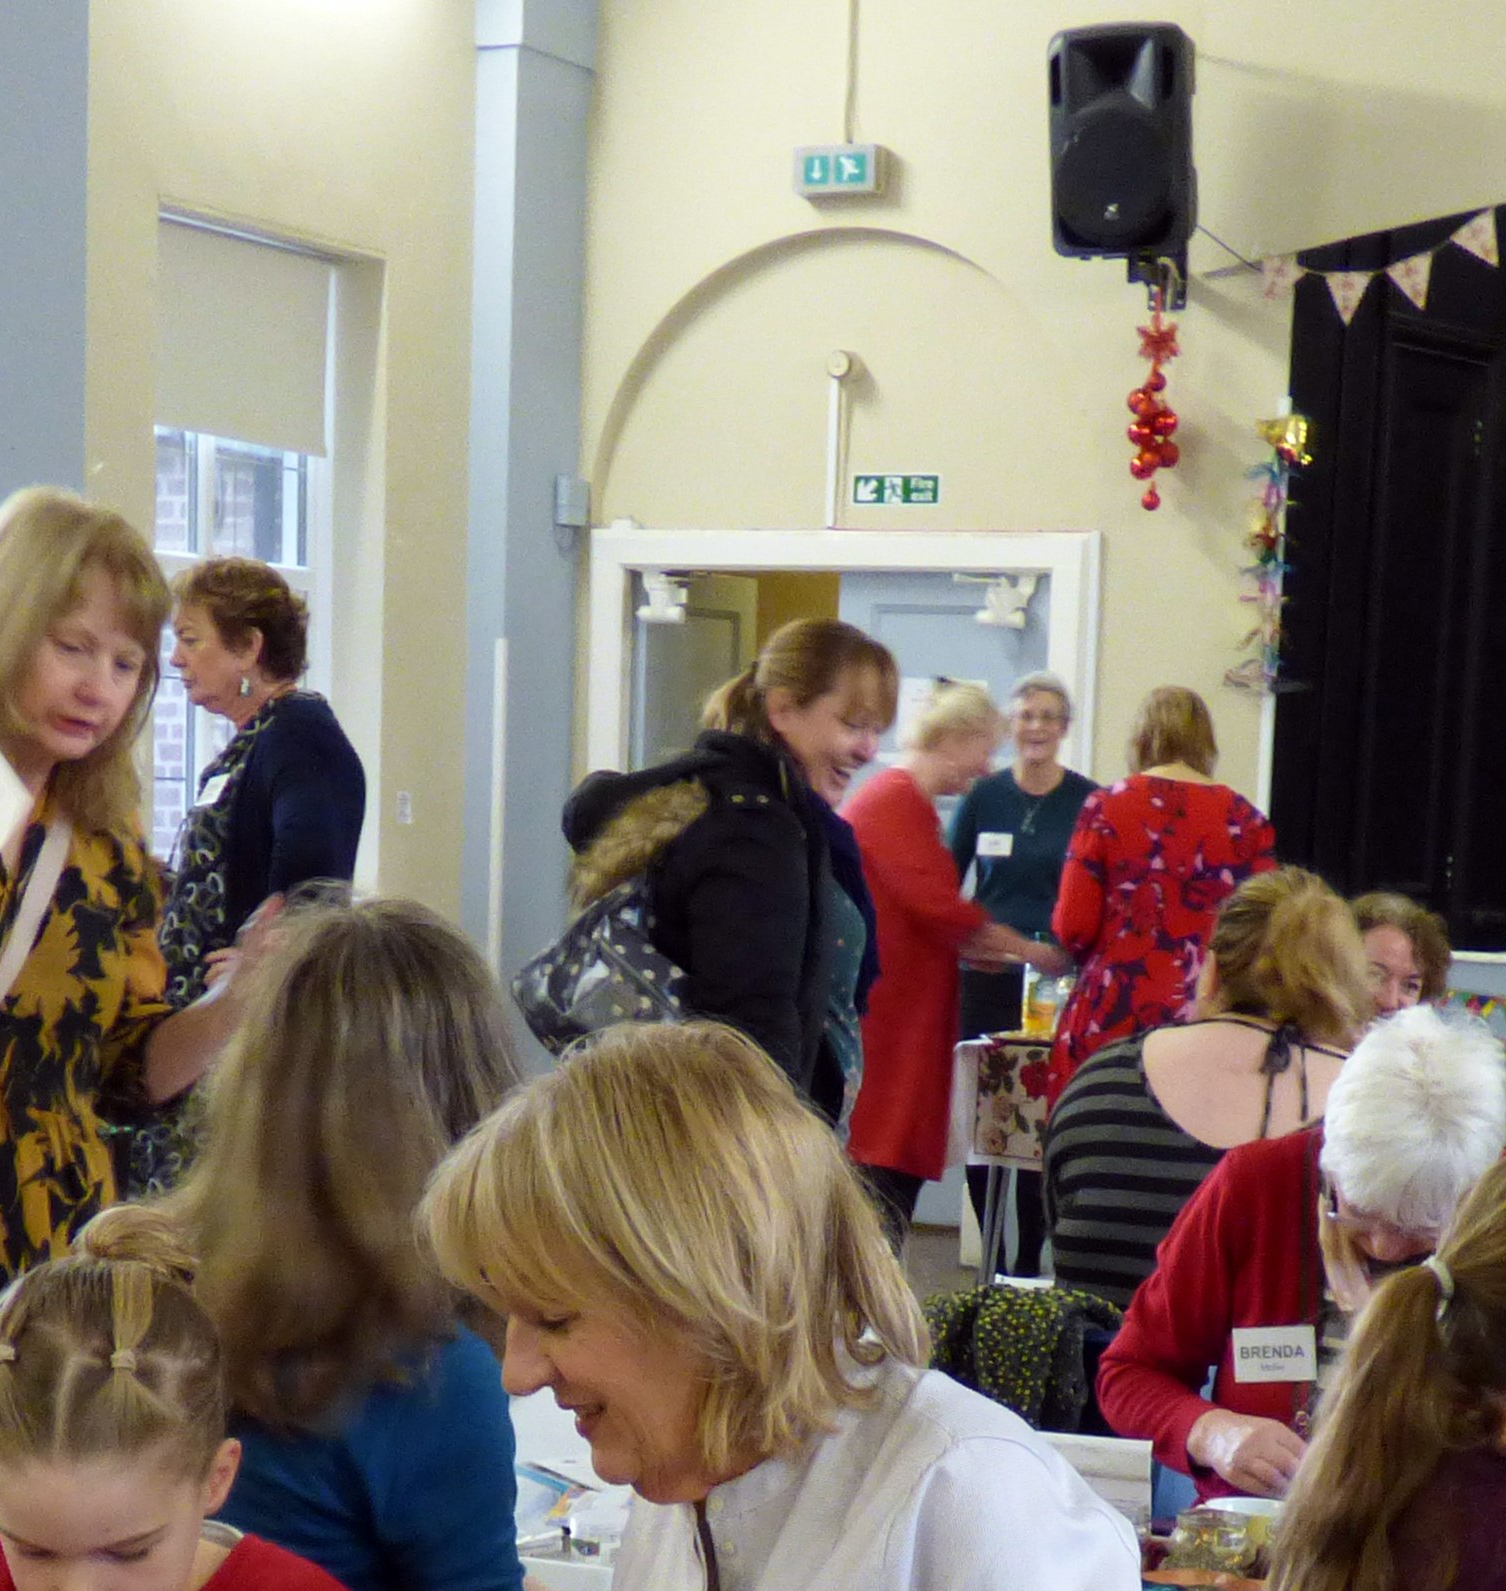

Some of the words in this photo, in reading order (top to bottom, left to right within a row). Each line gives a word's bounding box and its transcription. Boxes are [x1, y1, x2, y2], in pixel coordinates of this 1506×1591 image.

[910, 477, 934, 490] Fire
[909, 491, 934, 502] exit
[1239, 1344, 1306, 1360] BRENDA
